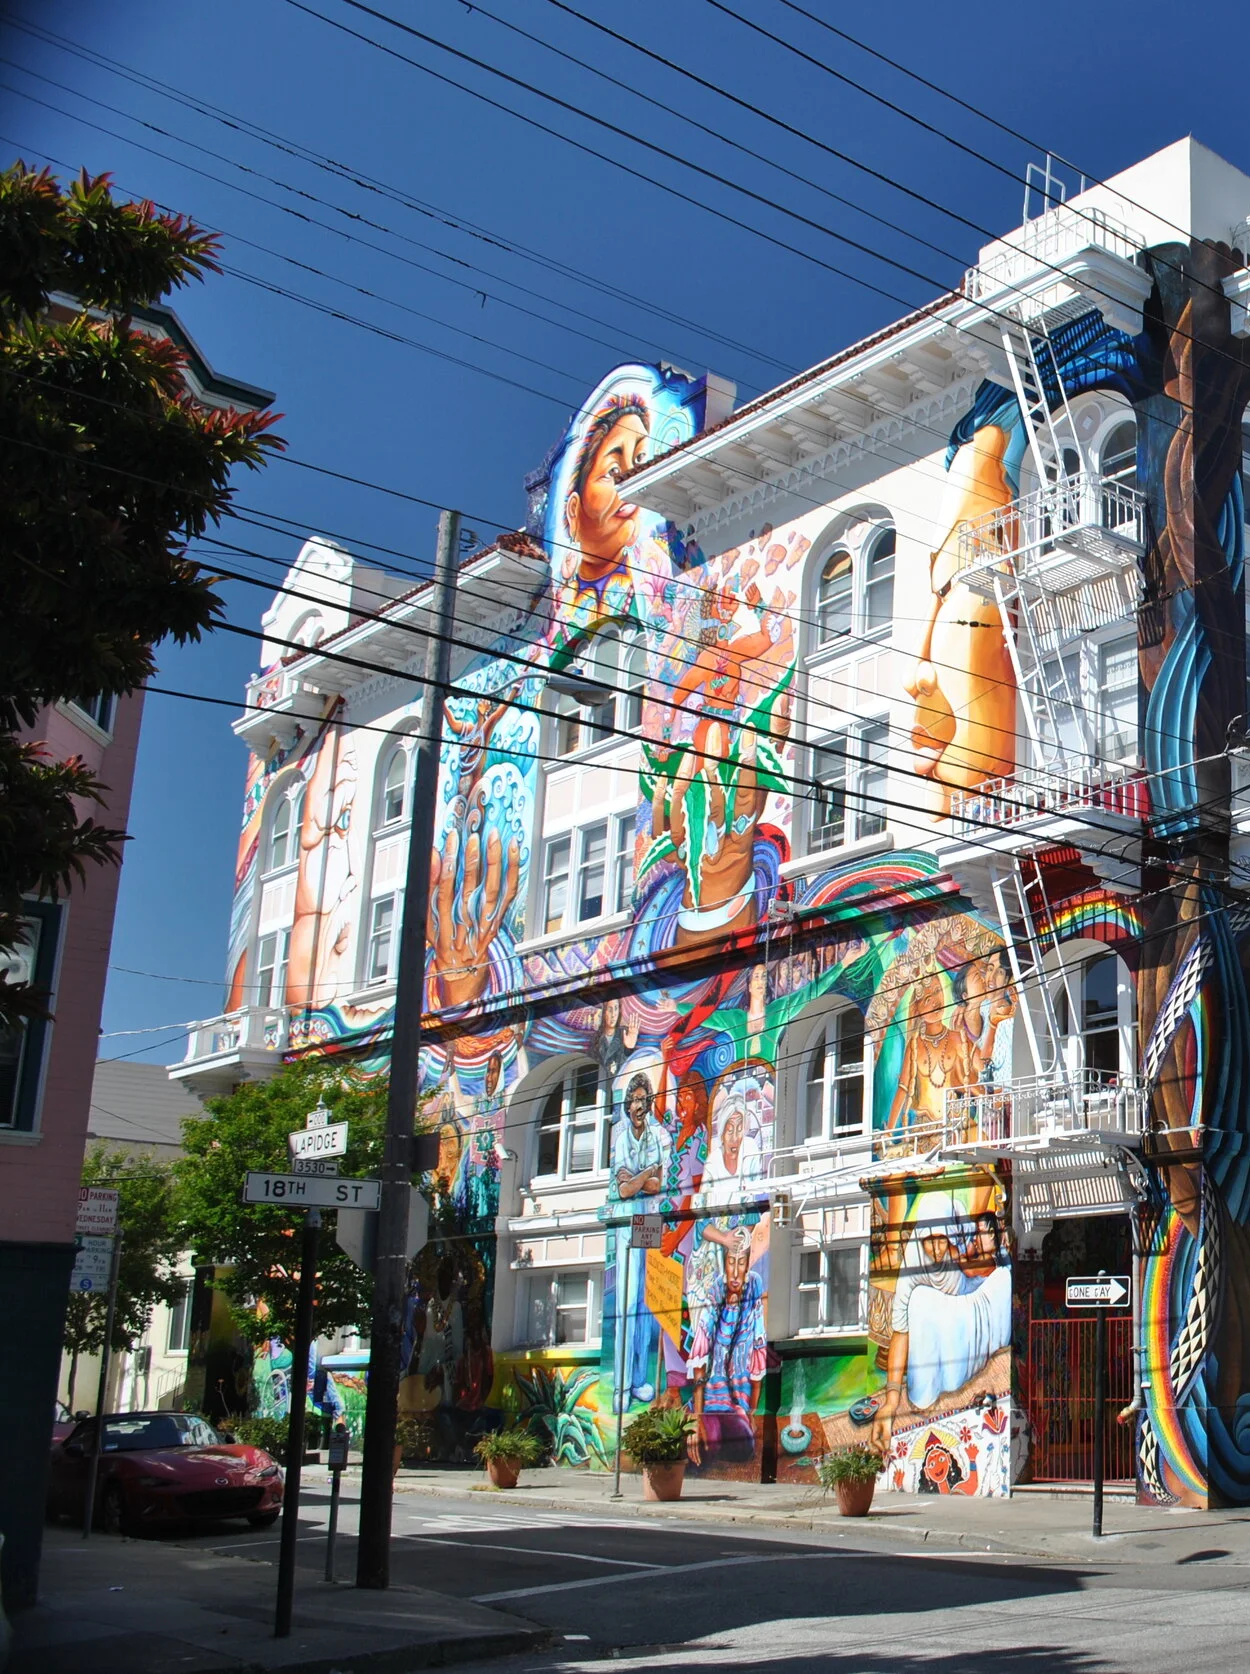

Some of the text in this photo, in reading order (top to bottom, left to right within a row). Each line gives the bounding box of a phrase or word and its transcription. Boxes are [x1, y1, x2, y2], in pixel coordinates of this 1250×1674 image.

[295, 1131, 338, 1155] LAPIDGE
[297, 1161, 325, 1174] 3530
[89, 1191, 117, 1202] PARKING
[264, 1180, 363, 1202] 18TH ST
[634, 1215, 644, 1225] NO
[635, 1226, 660, 1234] PARKING
